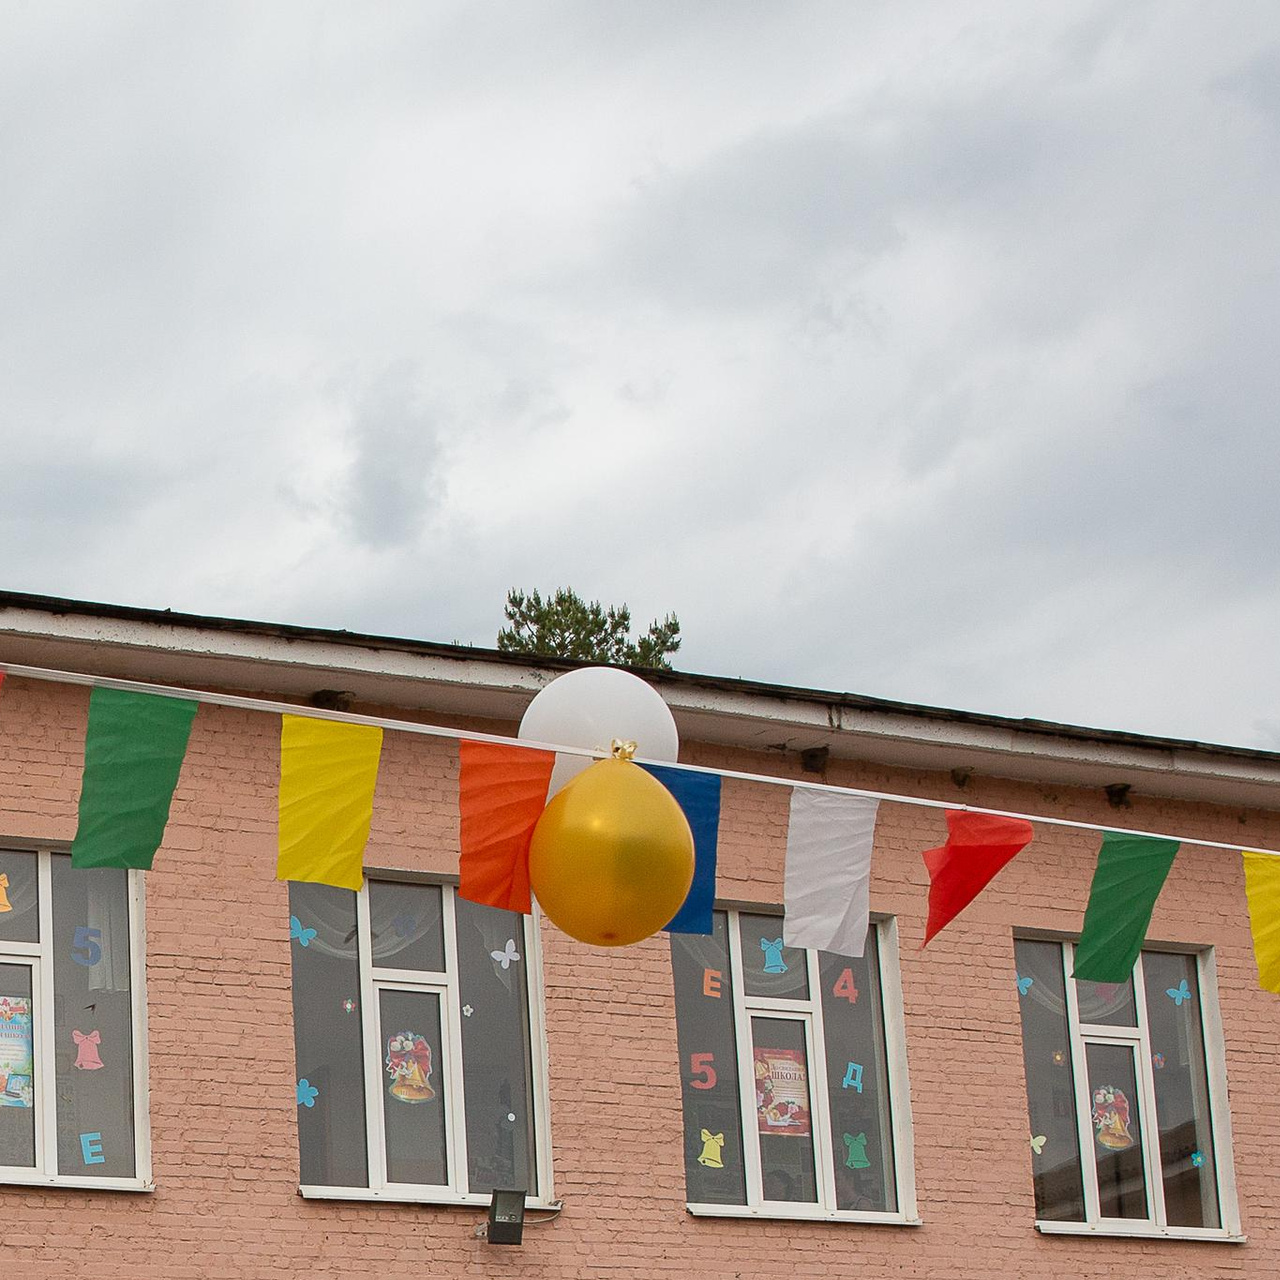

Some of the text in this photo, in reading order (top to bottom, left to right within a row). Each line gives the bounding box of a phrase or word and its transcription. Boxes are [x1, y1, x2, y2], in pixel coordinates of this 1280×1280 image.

[70, 926, 102, 966] 5
[703, 969, 722, 998] Е
[833, 968, 858, 1004] 4
[690, 1053, 717, 1090] 5
[842, 1061, 864, 1094] Д
[79, 1132, 105, 1165] Е
